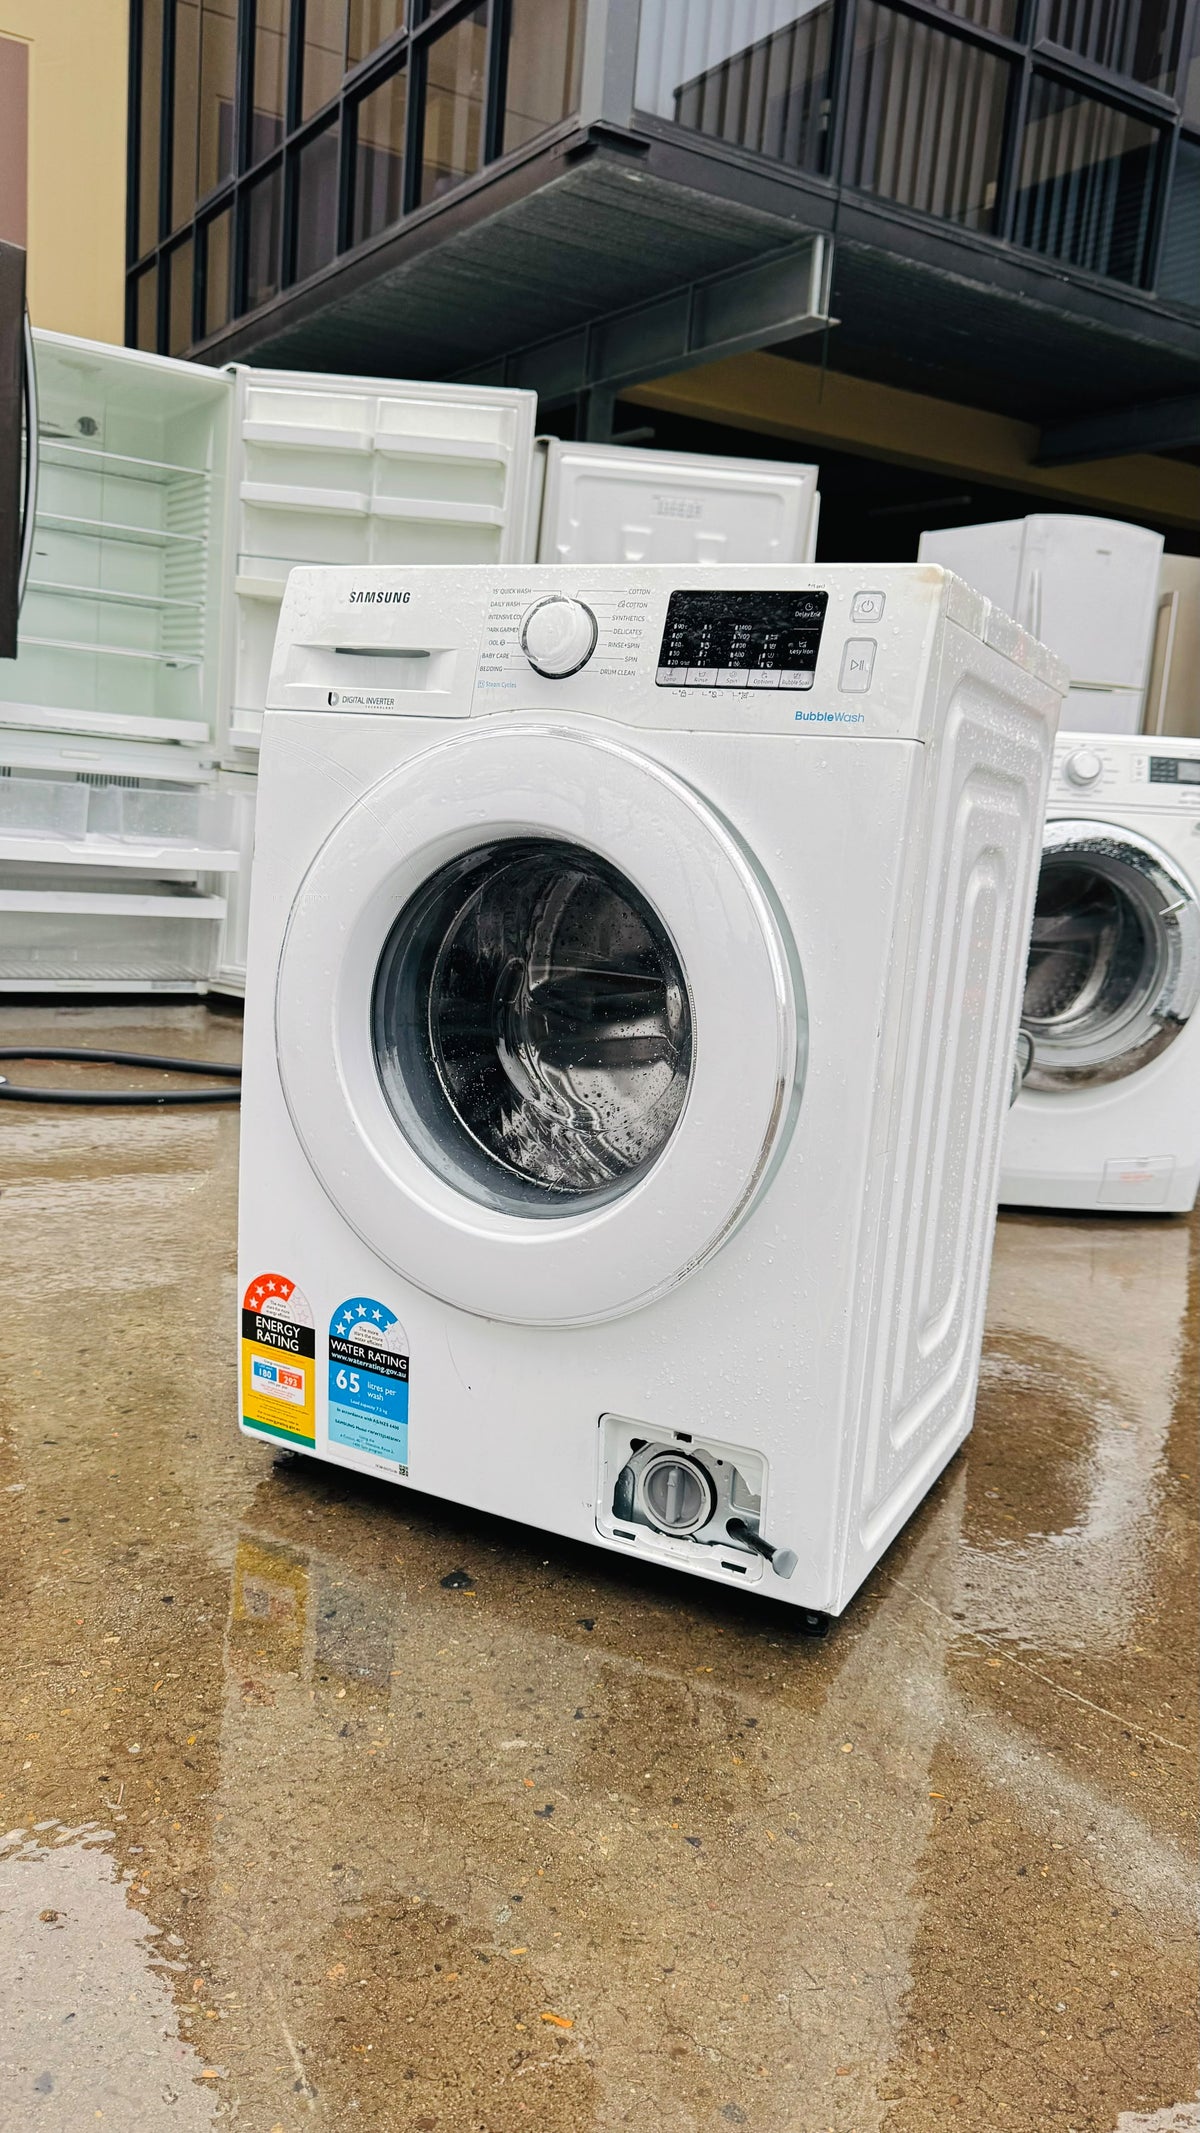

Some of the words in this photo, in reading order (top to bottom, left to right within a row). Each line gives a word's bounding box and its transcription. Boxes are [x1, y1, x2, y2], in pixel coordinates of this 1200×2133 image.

[349, 591, 411, 604] SAMSUNG
[342, 695, 365, 704] DIGITAL
[365, 696, 395, 706] INVERTER
[794, 710, 865, 722] BubbleWash
[255, 1315, 301, 1339] ENERGY
[256, 1328, 299, 1352] RATING
[330, 1338, 366, 1359] WATER
[368, 1349, 407, 1370] RATING
[331, 1351, 407, 1378] www.waterrating.gov.au
[259, 1367, 272, 1379] 180
[283, 1375, 298, 1387] 293
[336, 1369, 360, 1393] 65
[367, 1381, 383, 1392] litres
[384, 1387, 397, 1396] per
[367, 1391, 384, 1401] wash
